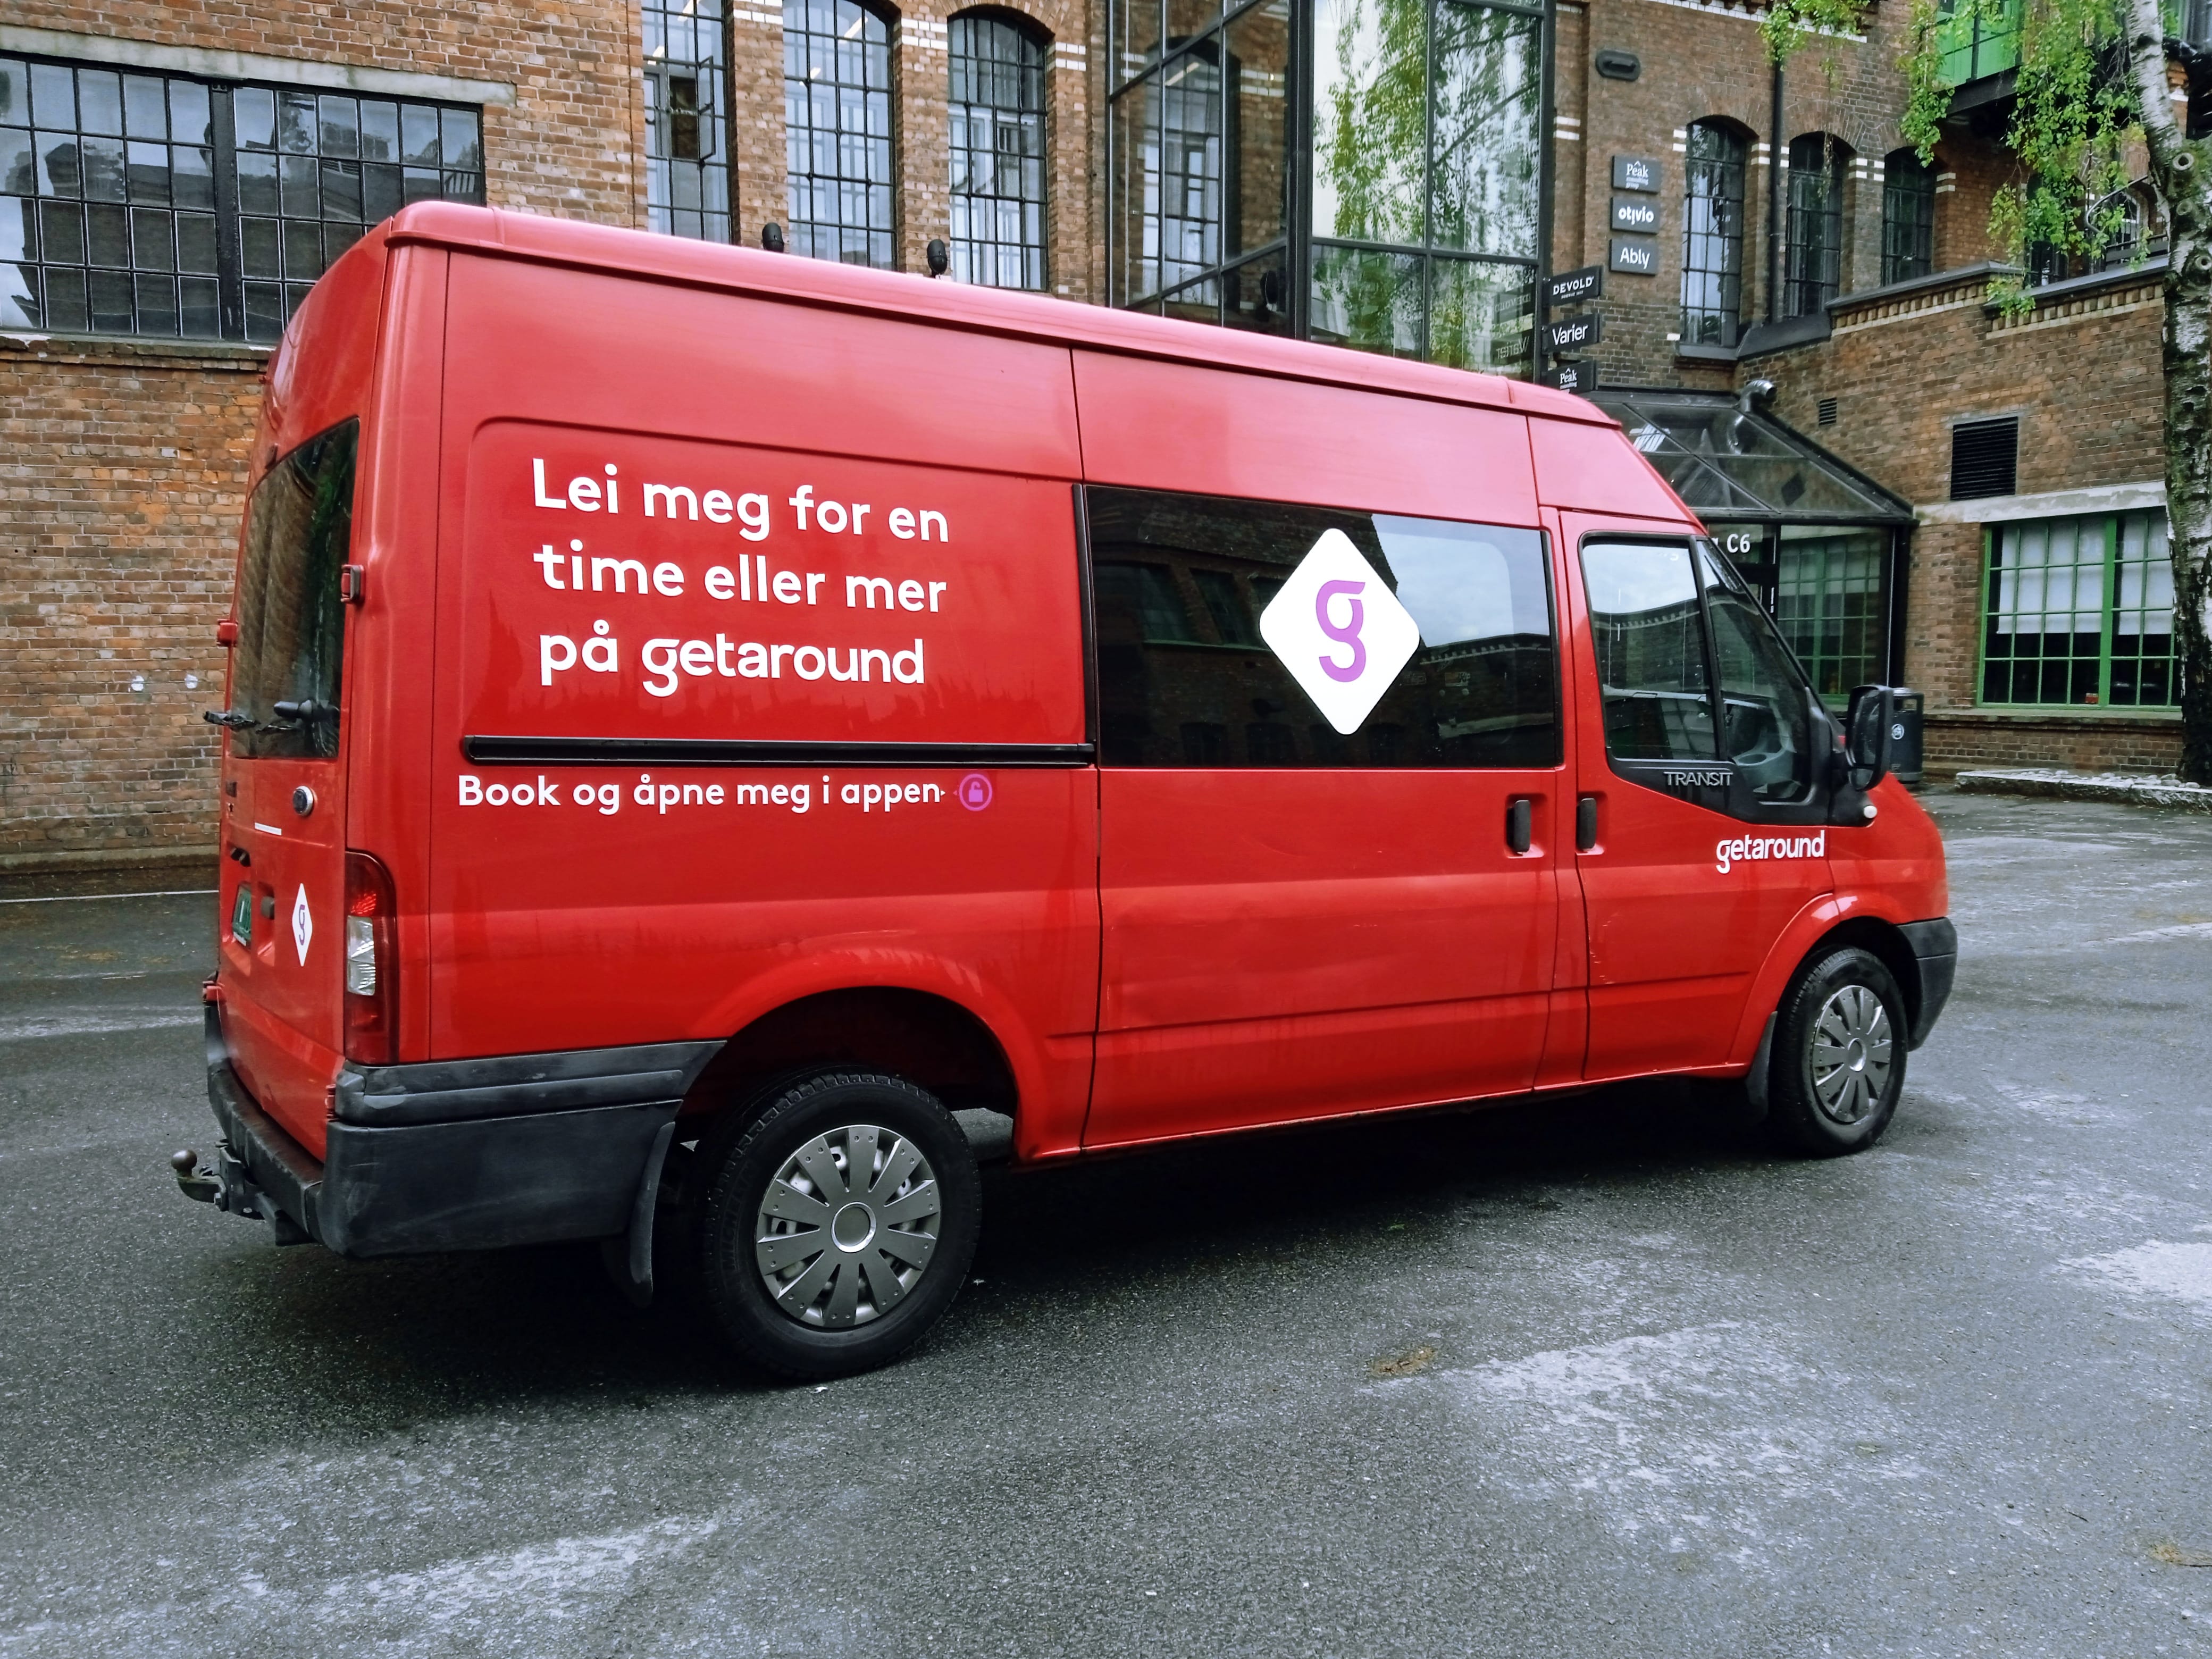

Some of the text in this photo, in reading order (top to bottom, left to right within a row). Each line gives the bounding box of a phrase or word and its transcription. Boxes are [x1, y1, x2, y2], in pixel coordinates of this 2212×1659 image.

[1626, 163, 1649, 179] Peak
[1619, 247, 1650, 269] Ably
[1553, 276, 1594, 295] DEVOLD
[1552, 323, 1588, 346] Varier
[1560, 369, 1577, 384] Peak
[533, 458, 949, 542] Lei meg for en
[1727, 533, 1750, 553] C6
[533, 539, 947, 613] time eller mer
[540, 619, 924, 697] på getaround
[1663, 772, 1733, 786] TRANSIT
[459, 774, 940, 815] Book og åpne meg i appen
[1716, 830, 1825, 874] getaround
